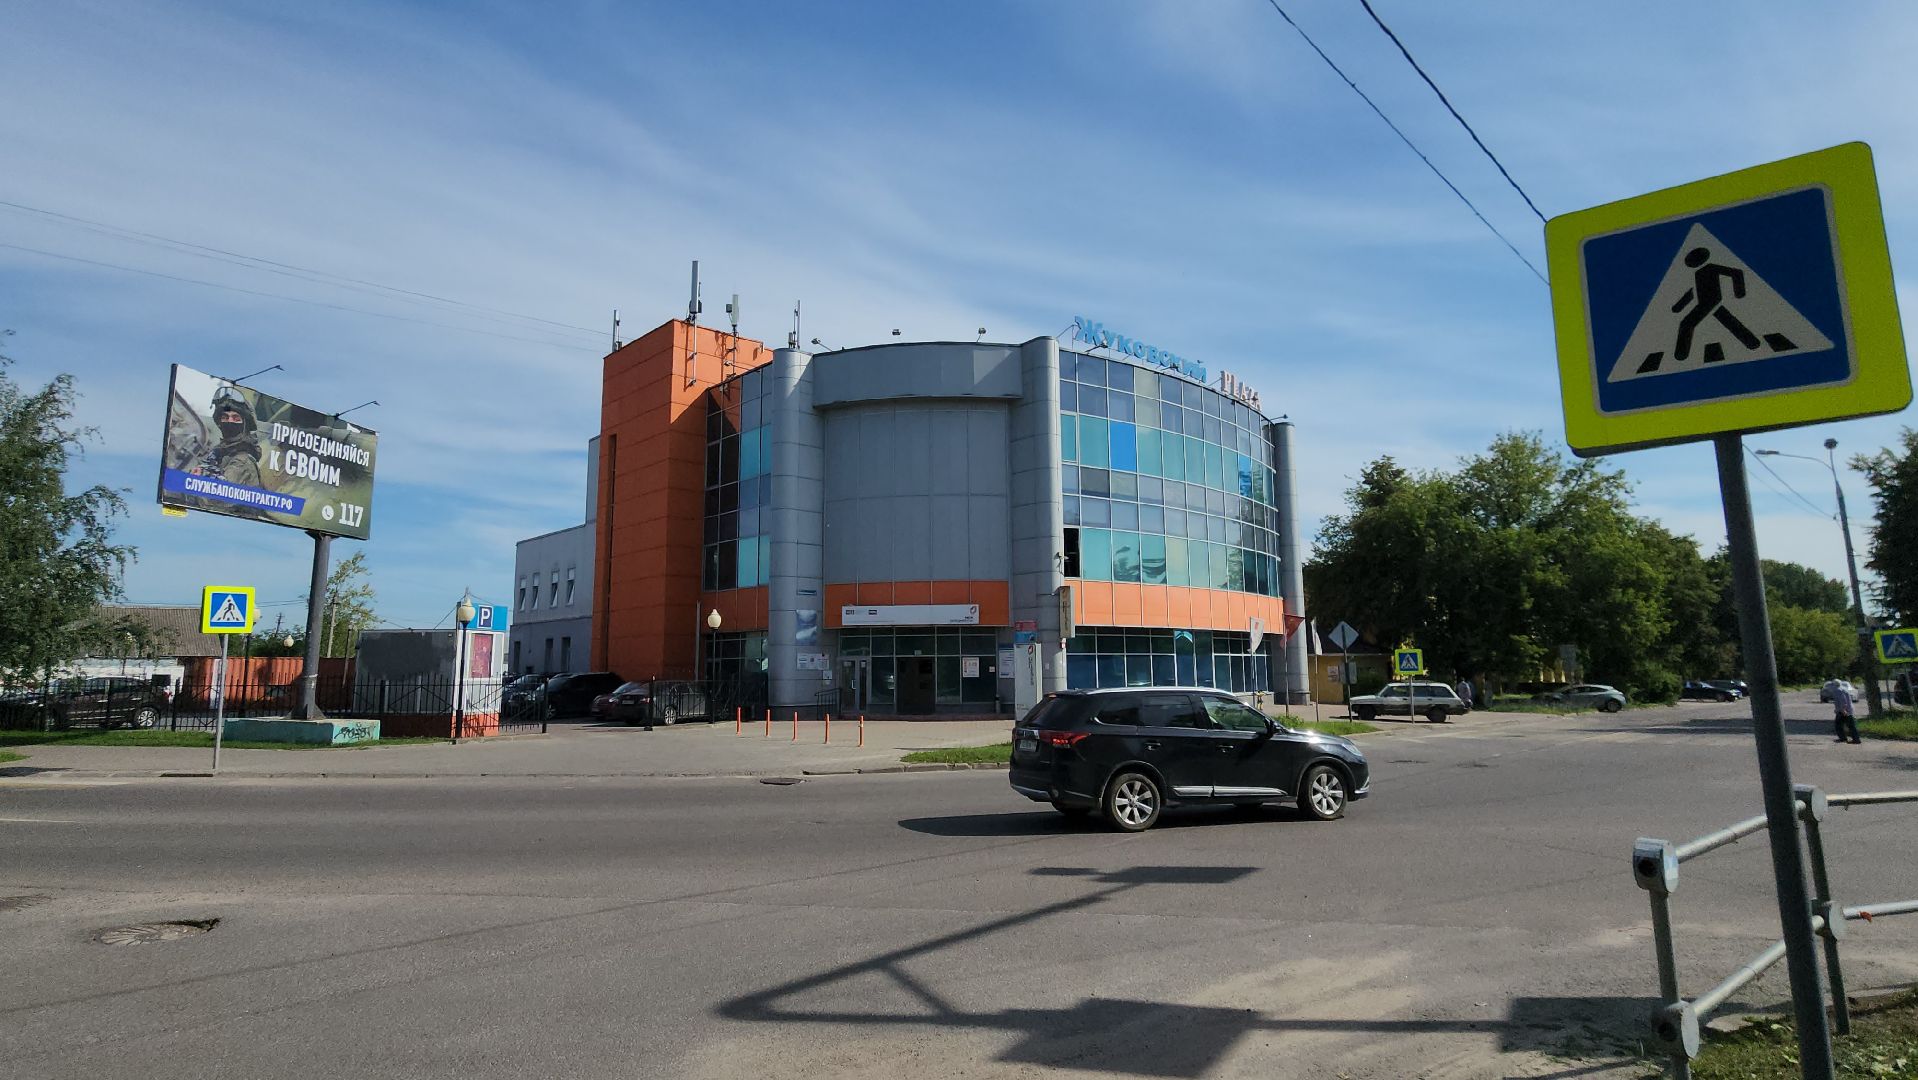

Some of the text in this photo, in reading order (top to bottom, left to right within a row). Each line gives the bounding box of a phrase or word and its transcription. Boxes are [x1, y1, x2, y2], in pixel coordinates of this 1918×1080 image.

[272, 422, 370, 467] ПРИСОЕДИНЯЙСЯ
[185, 477, 293, 510] СЛУЖБАПОКОНТРАКТУ.РФ
[339, 502, 364, 528] 117
[480, 607, 491, 626] P
